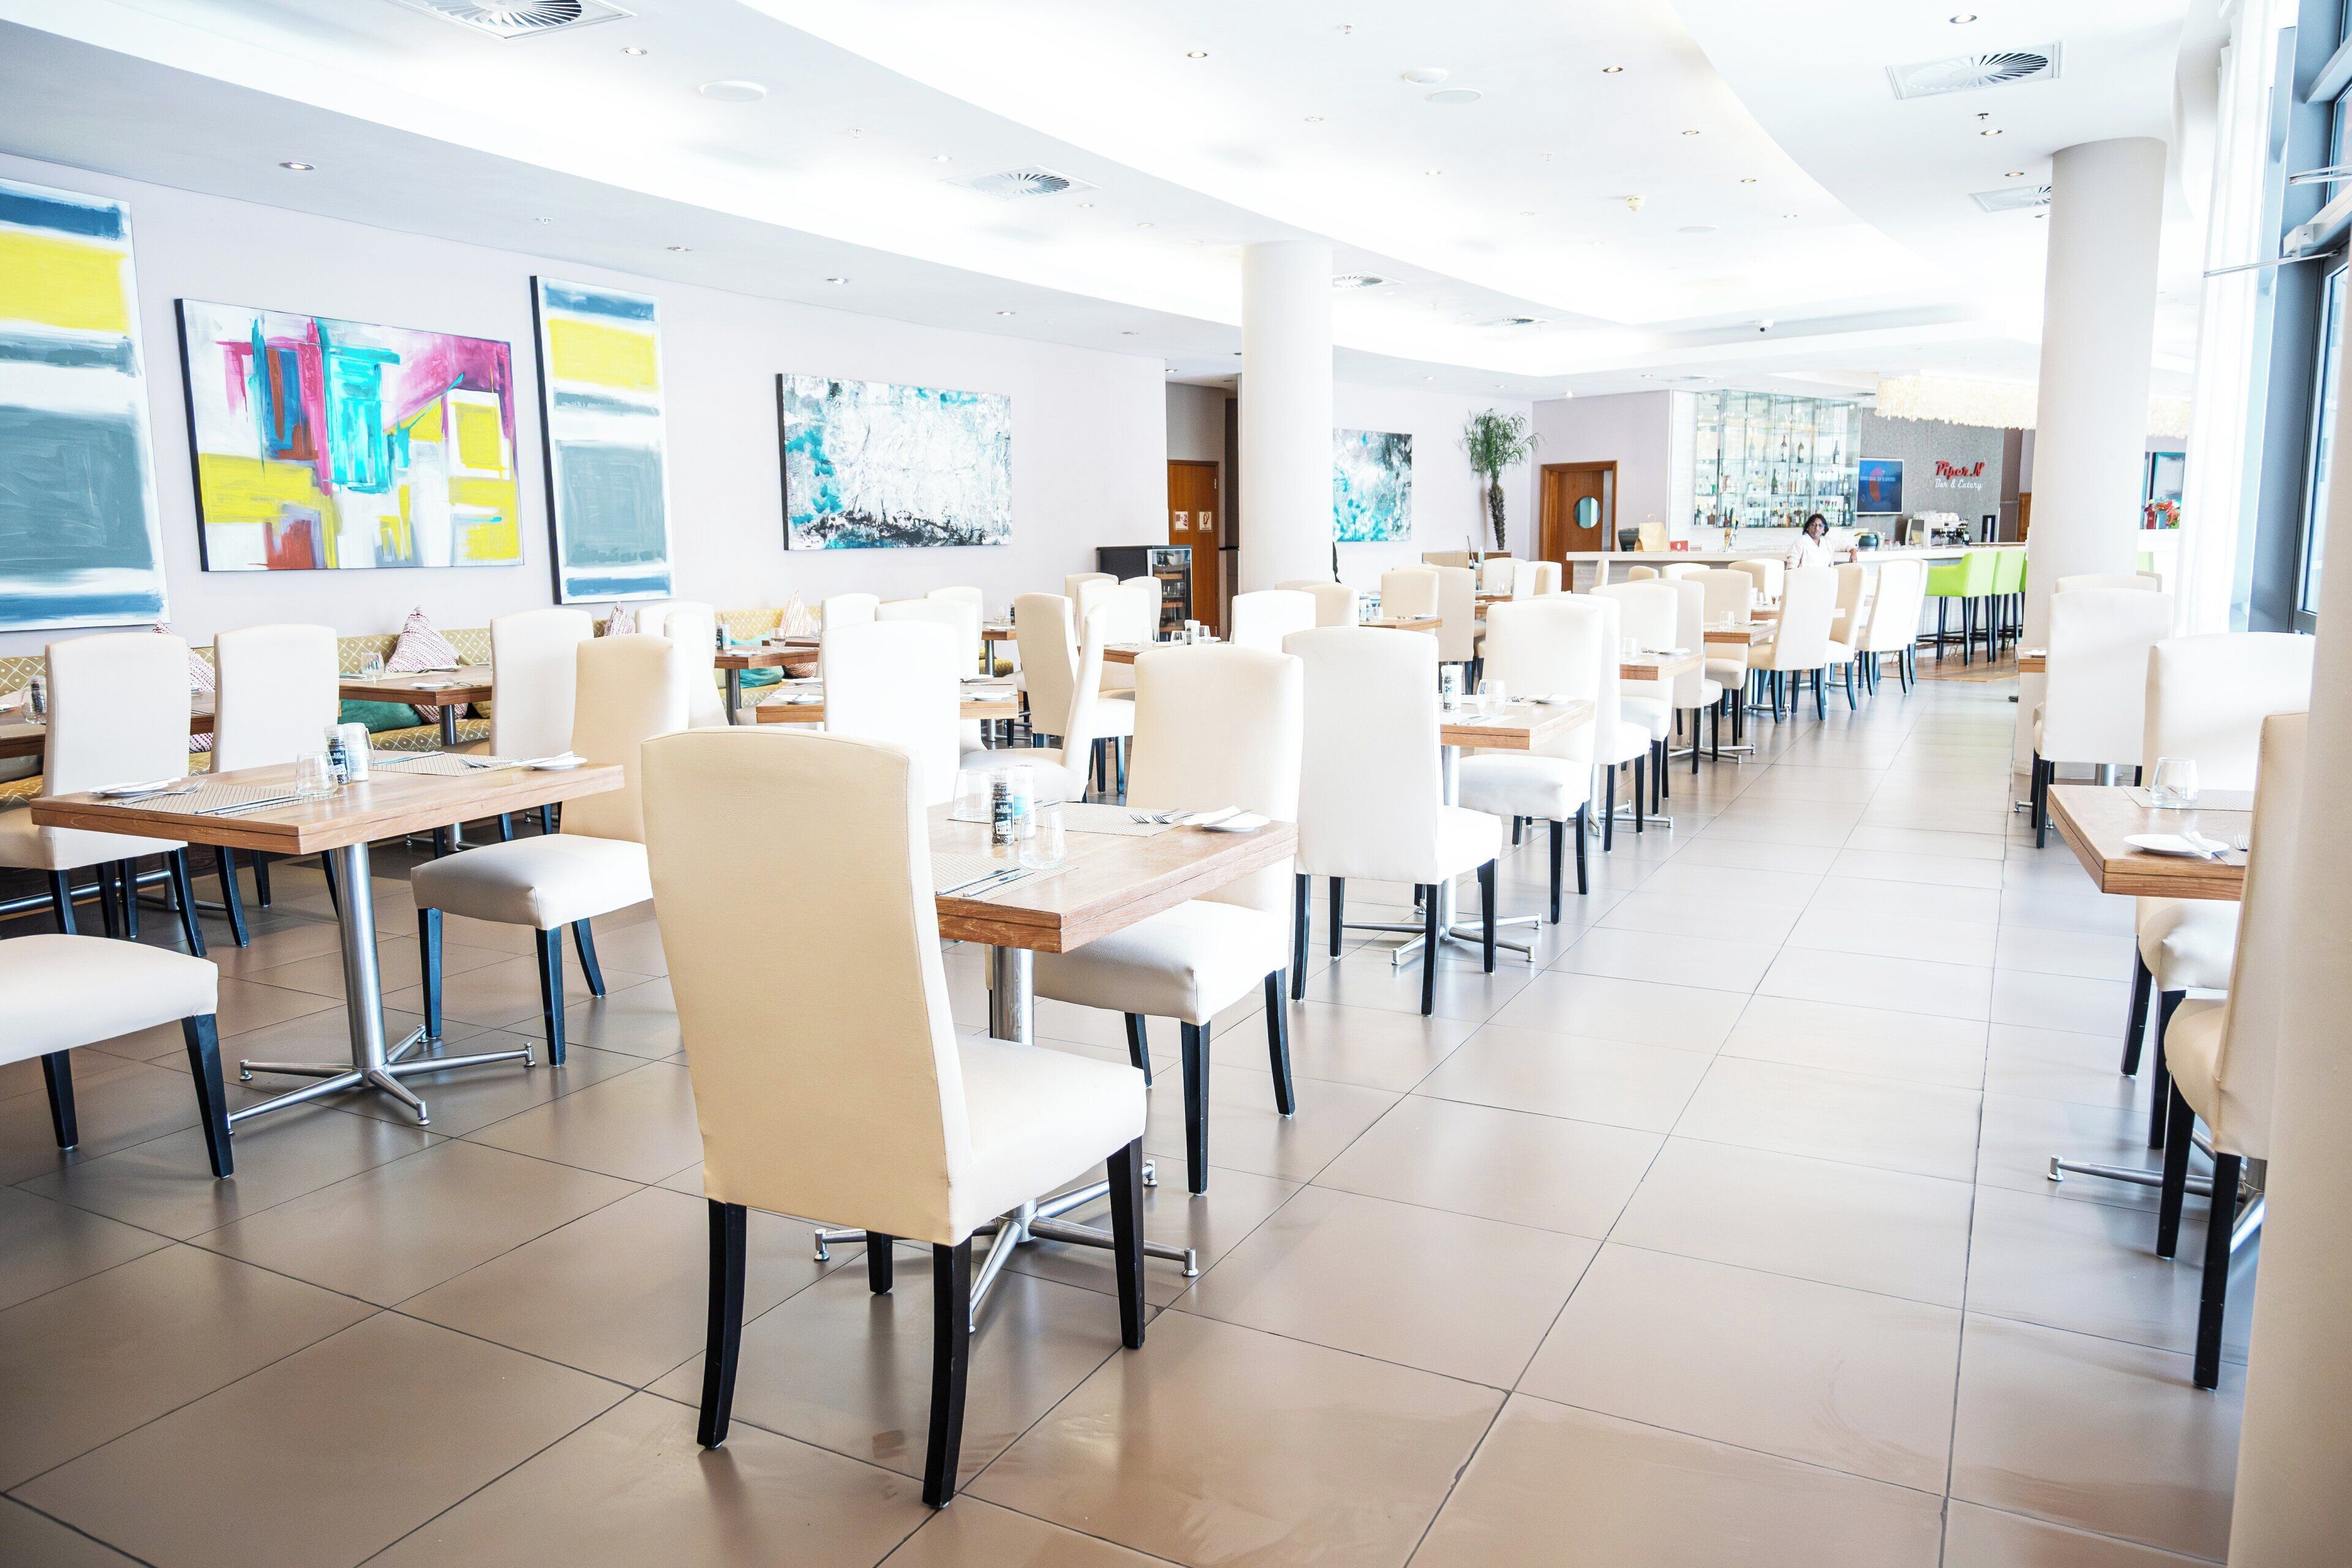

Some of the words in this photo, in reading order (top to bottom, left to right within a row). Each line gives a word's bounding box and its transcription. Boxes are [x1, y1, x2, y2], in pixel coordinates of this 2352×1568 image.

[1936, 461, 1969, 480] Piper
[1935, 478, 1948, 488] Bar
[1950, 478, 1956, 488] &
[1958, 479, 1982, 491] Eatery
